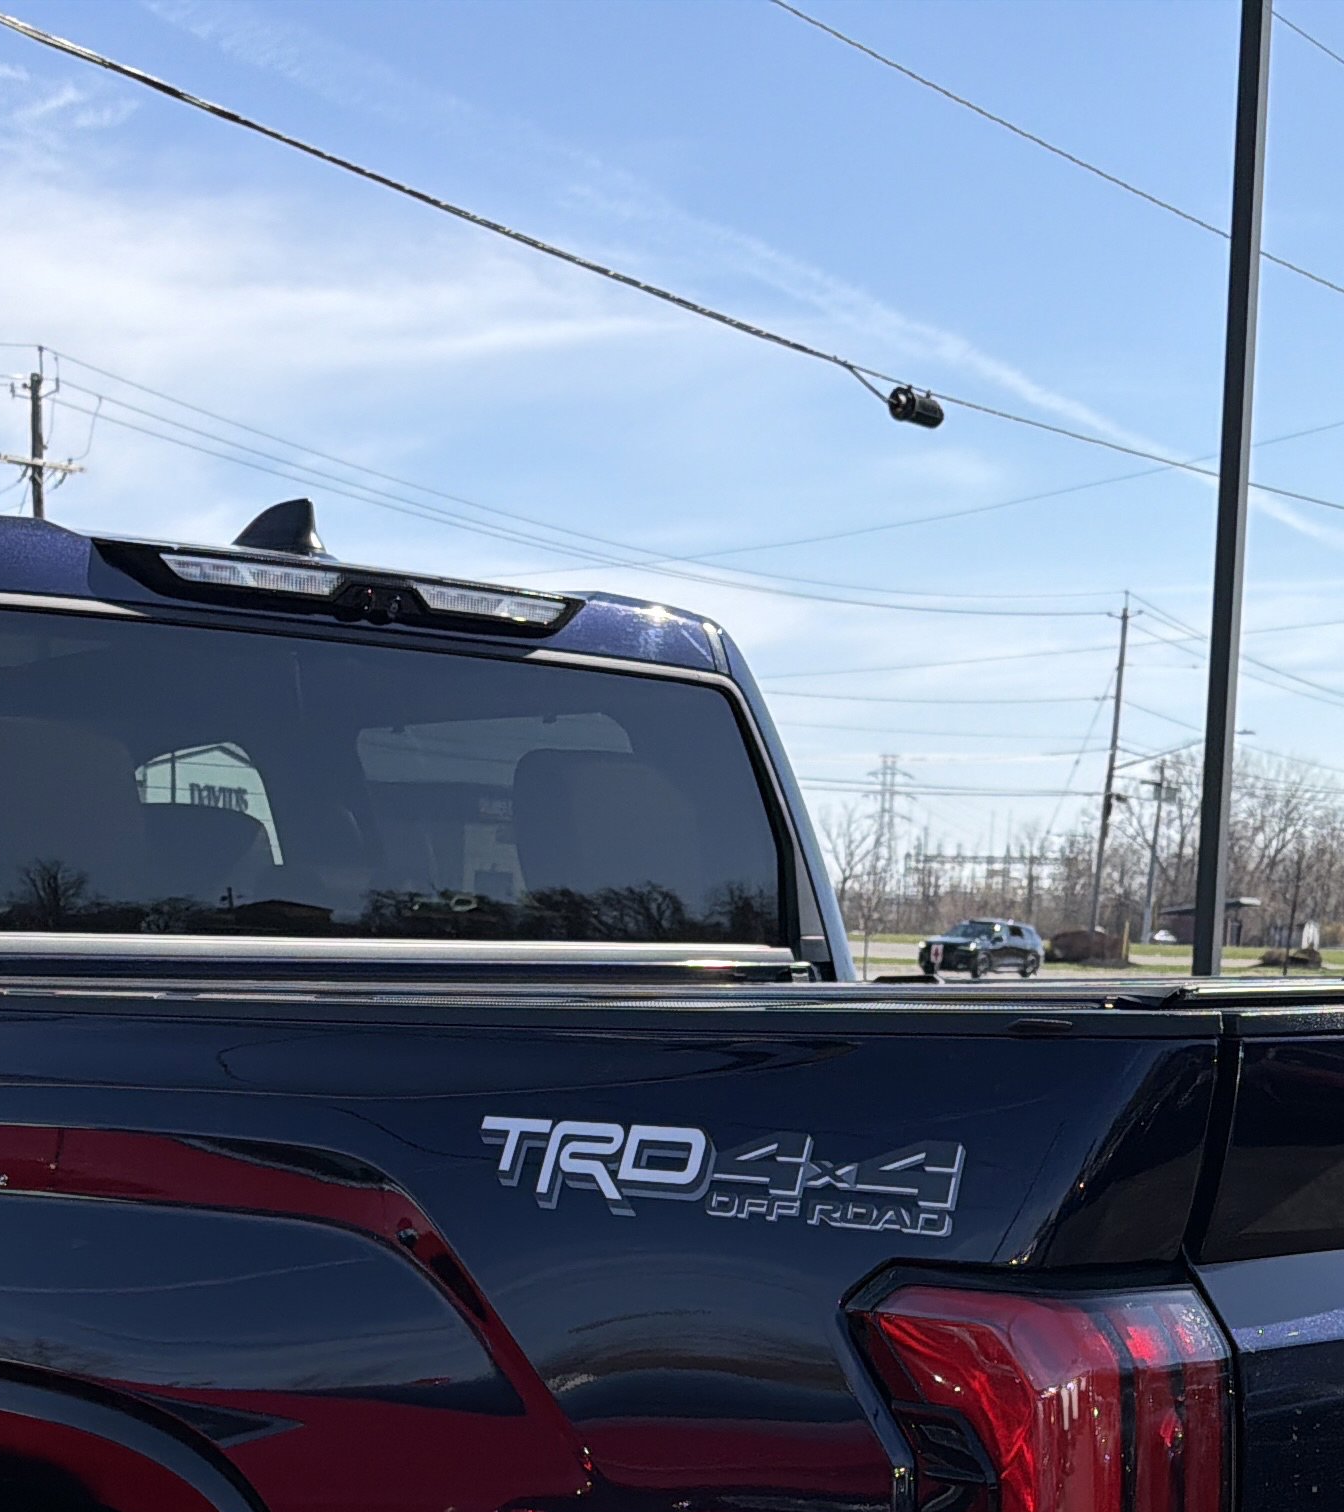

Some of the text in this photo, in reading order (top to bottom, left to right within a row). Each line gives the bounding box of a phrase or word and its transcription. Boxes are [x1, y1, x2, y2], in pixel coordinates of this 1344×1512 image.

[480, 1115, 718, 1217] TRD
[707, 1191, 953, 1237] OFF ROAD
